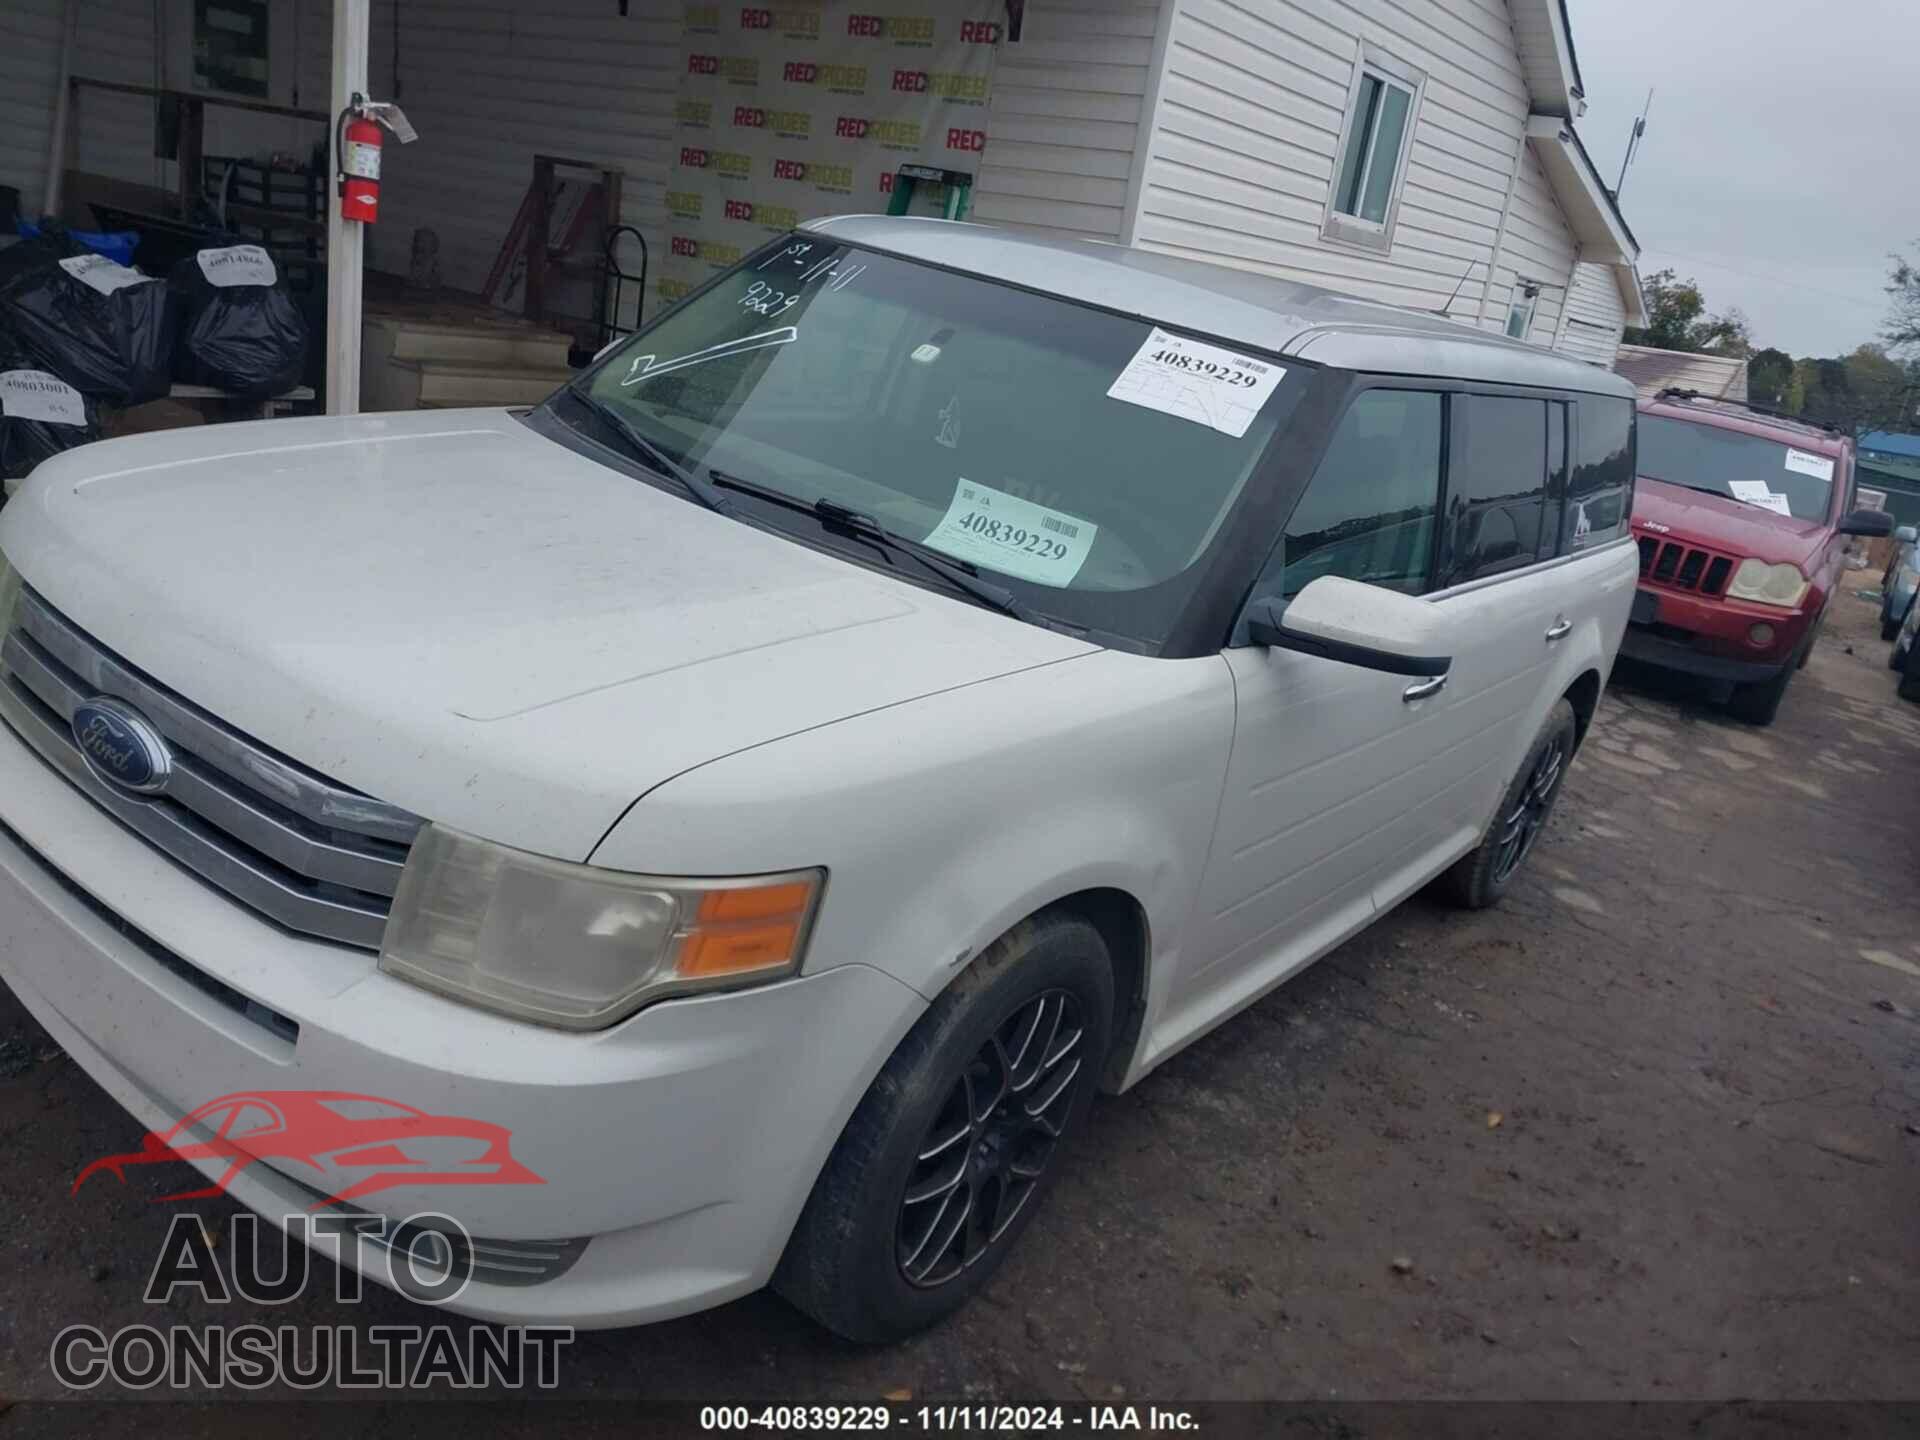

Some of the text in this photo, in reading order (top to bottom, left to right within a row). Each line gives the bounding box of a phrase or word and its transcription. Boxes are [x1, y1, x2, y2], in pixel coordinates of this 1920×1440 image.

[737, 281, 800, 318] 9229
[1151, 349, 1257, 389] 40839229
[959, 511, 1068, 561] 40839229
[1643, 520, 1670, 533] Jeep
[82, 714, 134, 773] Ford
